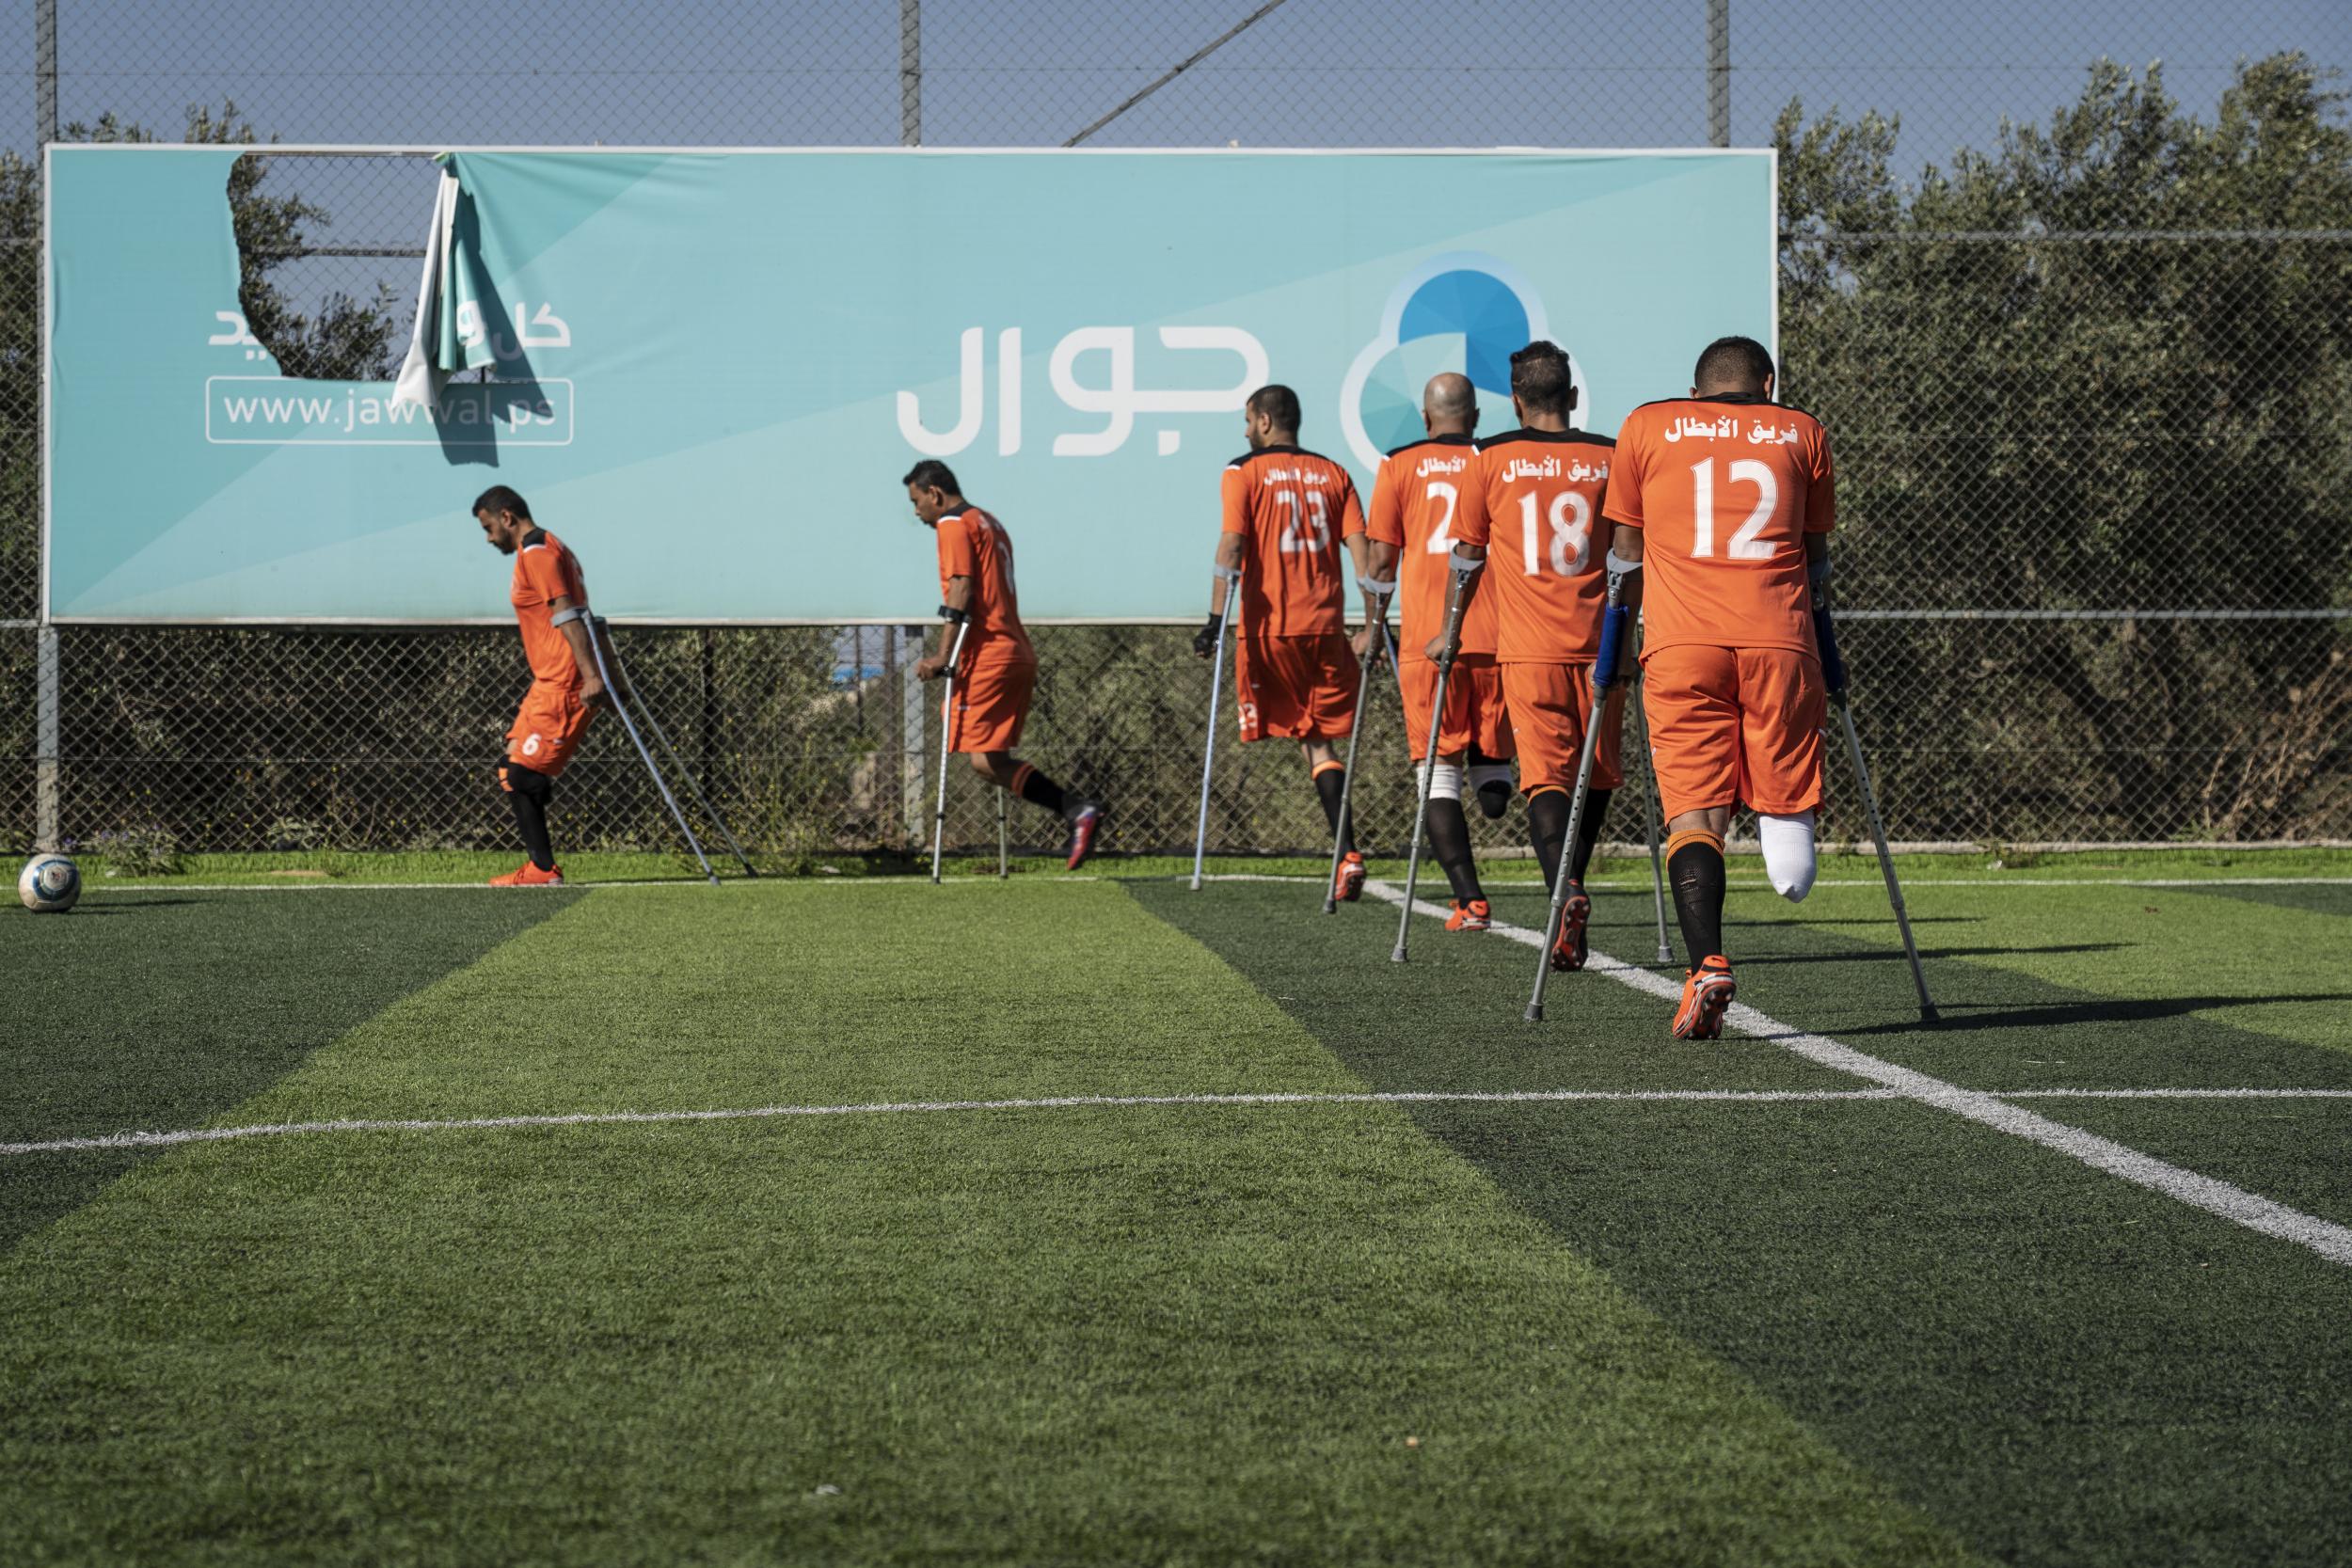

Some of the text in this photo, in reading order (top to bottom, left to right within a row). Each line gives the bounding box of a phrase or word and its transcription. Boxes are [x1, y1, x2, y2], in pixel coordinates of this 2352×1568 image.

[224, 388, 556, 434] www.jawwal.ps
[897, 325, 1270, 456] جوال
[1664, 415, 1799, 445] فريق الأبطال
[1502, 454, 1609, 483] فريق الأبطال
[1275, 489, 1331, 553] 23
[1426, 481, 1460, 555] 2
[1518, 490, 1591, 578] 18
[1691, 456, 1779, 560] 12
[522, 733, 543, 756] 6
